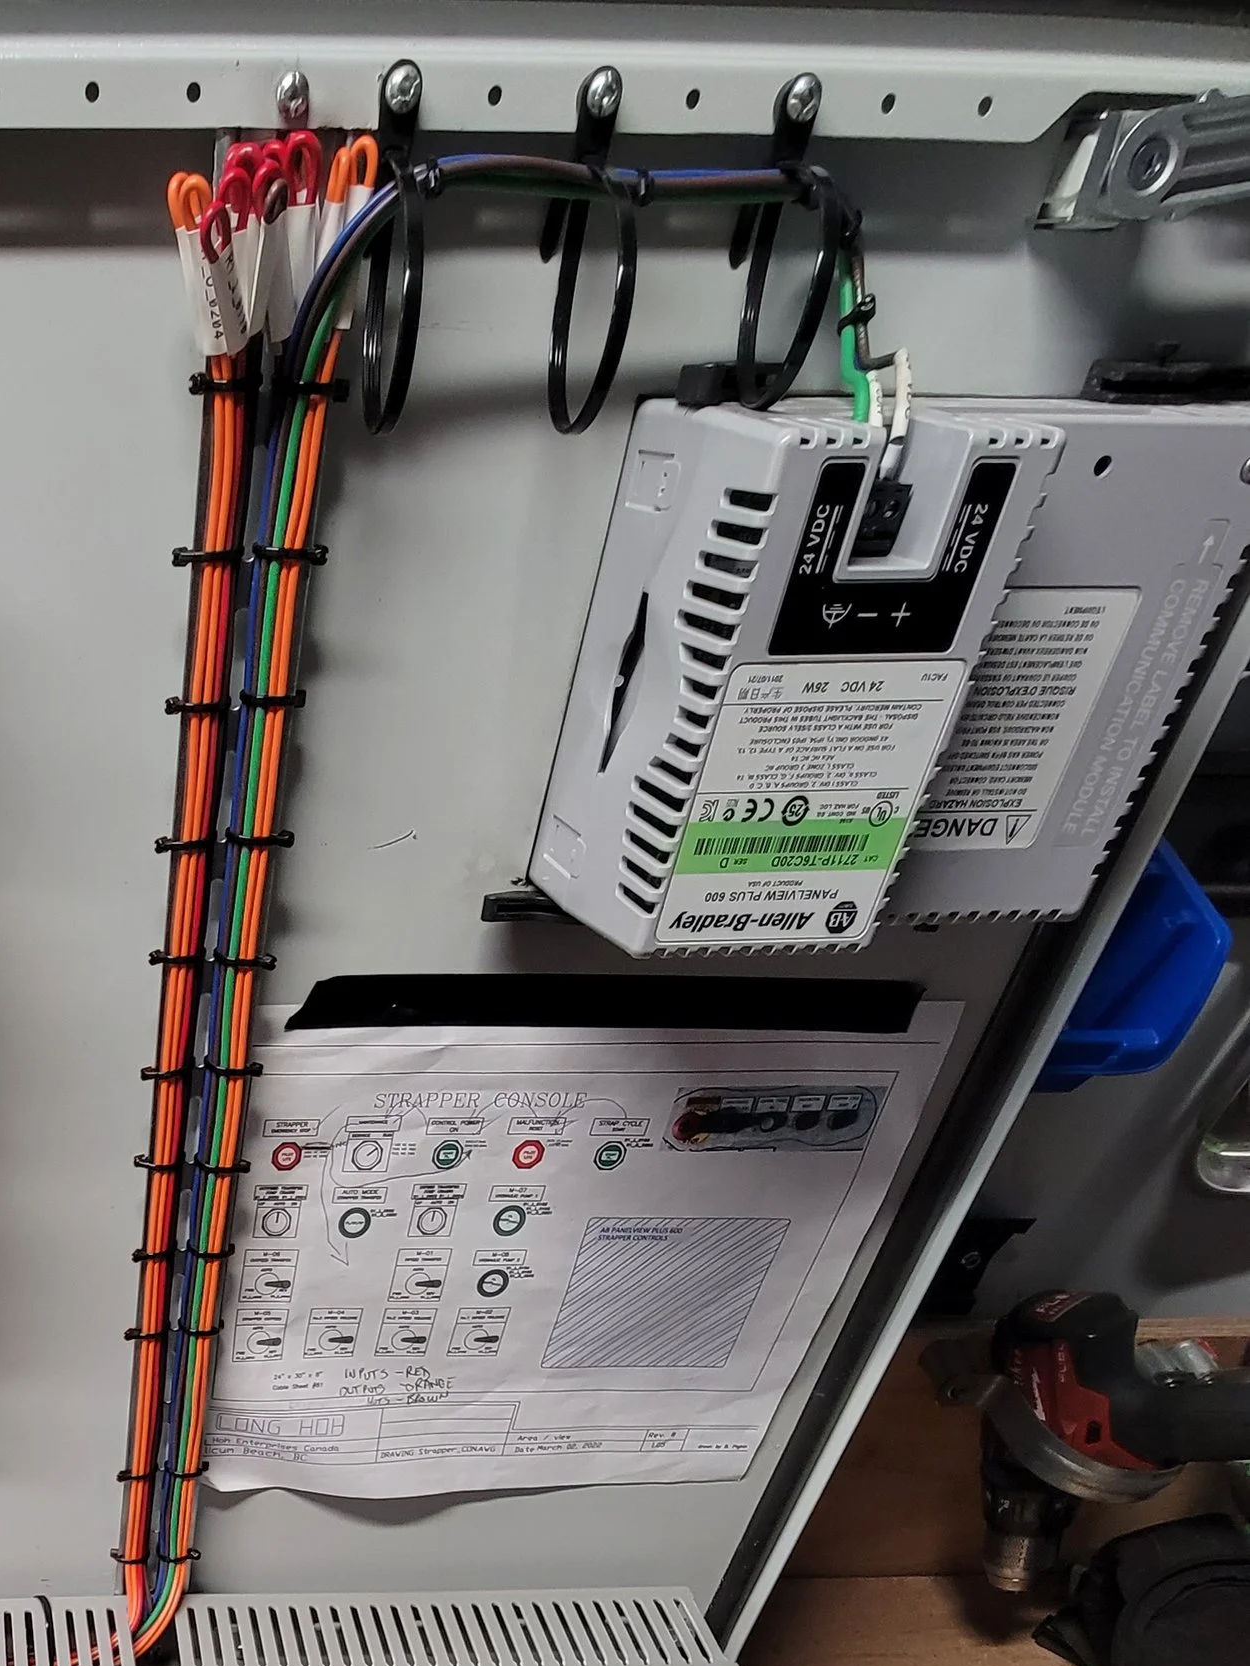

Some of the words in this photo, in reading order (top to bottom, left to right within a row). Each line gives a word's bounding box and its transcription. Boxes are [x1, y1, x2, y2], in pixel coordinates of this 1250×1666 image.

[971, 502, 988, 525] 24
[806, 503, 831, 548] VDC
[954, 531, 980, 574] VDC
[799, 552, 815, 575] 24
[840, 681, 866, 693] VDC
[868, 679, 886, 692] 24
[969, 799, 1023, 808] EXPLOSION
[912, 818, 999, 838] DANGE
[719, 857, 730, 868] D
[771, 853, 860, 868] 2711P-T6C20D
[704, 892, 726, 903] 600
[729, 890, 763, 902] PLUS
[765, 889, 839, 902] PANELVIEW
[668, 911, 815, 933] Allen-Bradley
[374, 1091, 481, 1110] STRAPPER
[494, 1091, 589, 1109] CONSOLE
[236, 1439, 299, 1452] Enterprises
[302, 1444, 340, 1453] Canada
[514, 1446, 535, 1454] Date
[293, 1452, 308, 1462] BC
